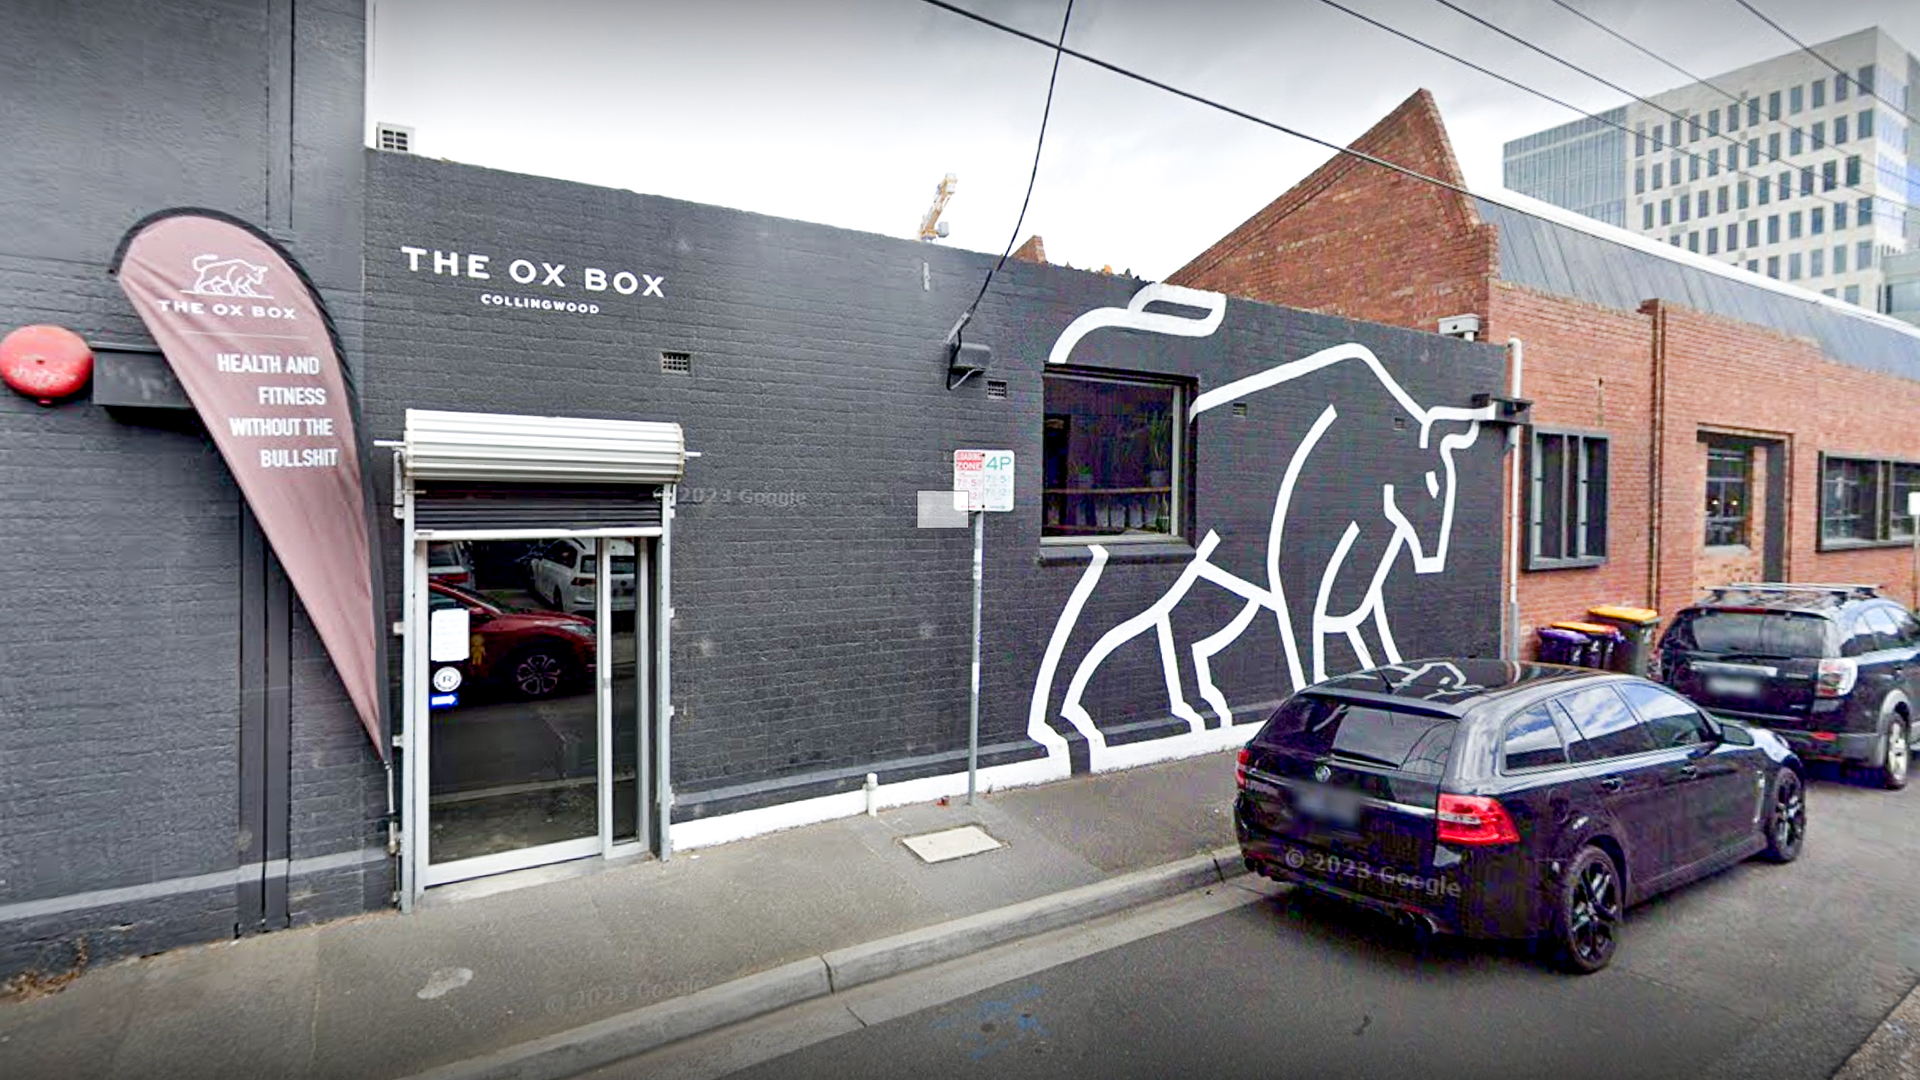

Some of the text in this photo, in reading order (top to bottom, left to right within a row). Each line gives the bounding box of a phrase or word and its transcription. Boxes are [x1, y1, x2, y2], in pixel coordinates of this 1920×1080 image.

[400, 246, 665, 298] THE OX BOX
[157, 299, 297, 320] THE OX BOX
[480, 293, 600, 315] COLLINGWOOD
[216, 353, 320, 375] HEALTH AND
[258, 386, 326, 405] FITNESS
[229, 417, 334, 437] WITHOUT THE
[260, 448, 339, 468] BULLSHIT
[956, 461, 982, 471] ZONE
[986, 456, 1012, 470] 4P
